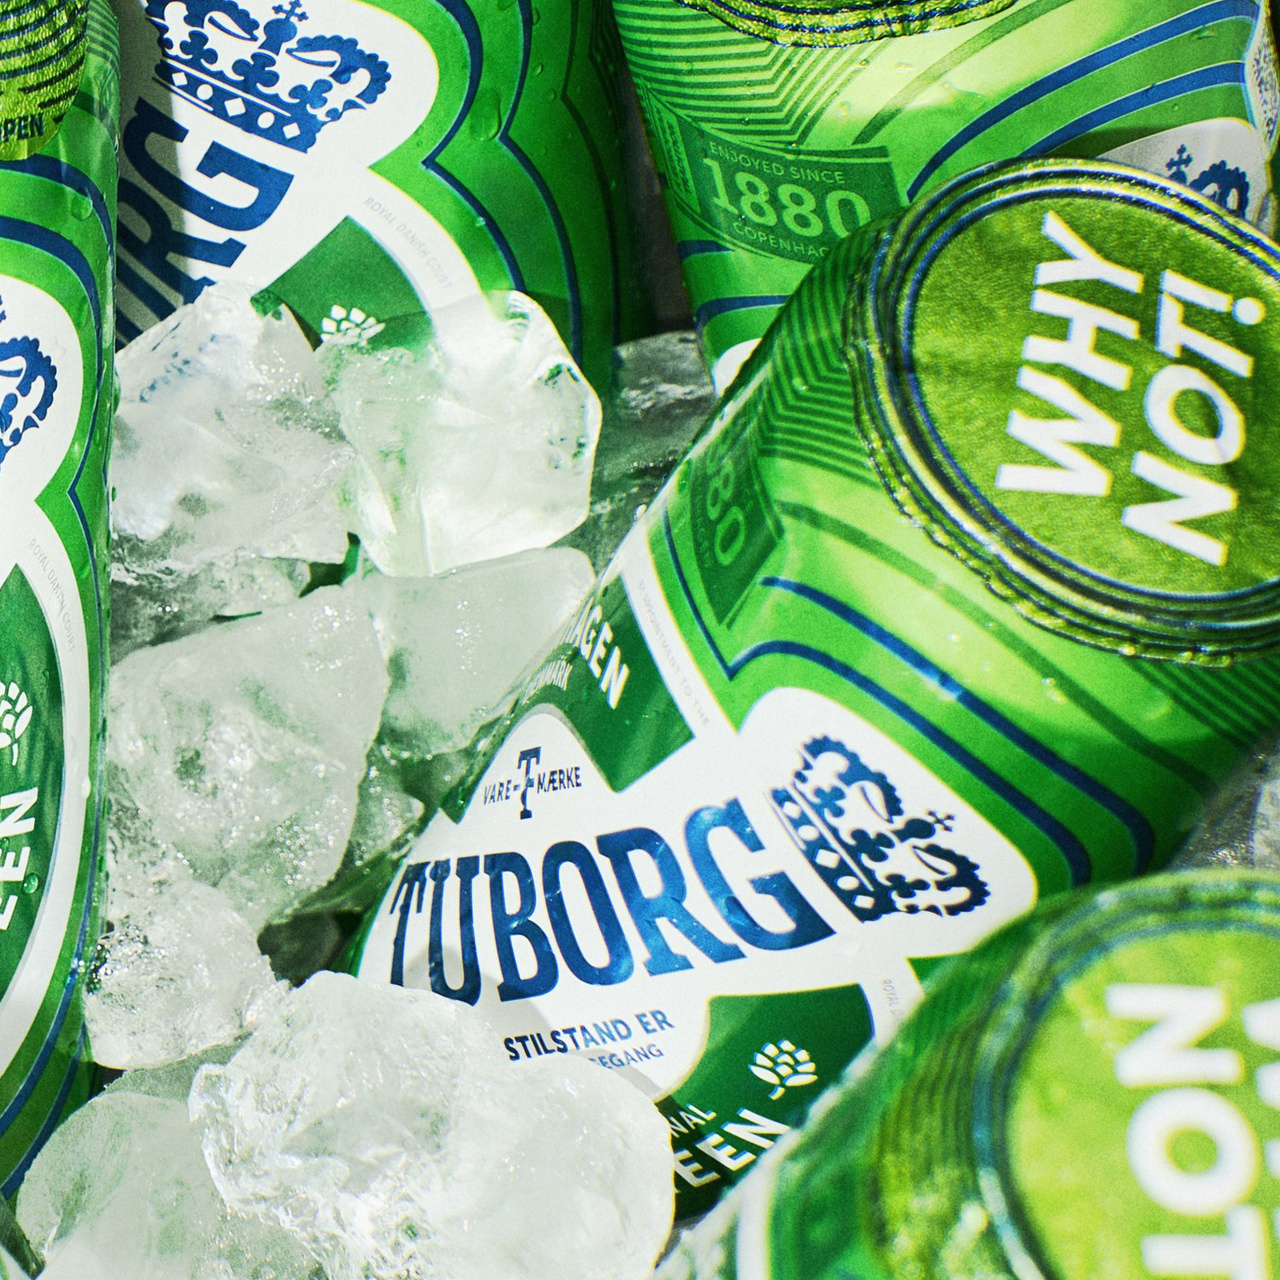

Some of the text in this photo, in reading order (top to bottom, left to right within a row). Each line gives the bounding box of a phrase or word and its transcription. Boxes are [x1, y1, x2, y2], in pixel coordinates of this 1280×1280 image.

[702, 157, 871, 240] 1880
[709, 141, 846, 185] ENJOYED SINCE
[732, 221, 829, 258] COPENHA
[995, 209, 1145, 498] WHY
[1121, 268, 1267, 567] NOT!
[390, 795, 837, 1006] TUBORG
[504, 1009, 676, 1061] STILSTAND ER
[673, 1107, 791, 1187] EEN
